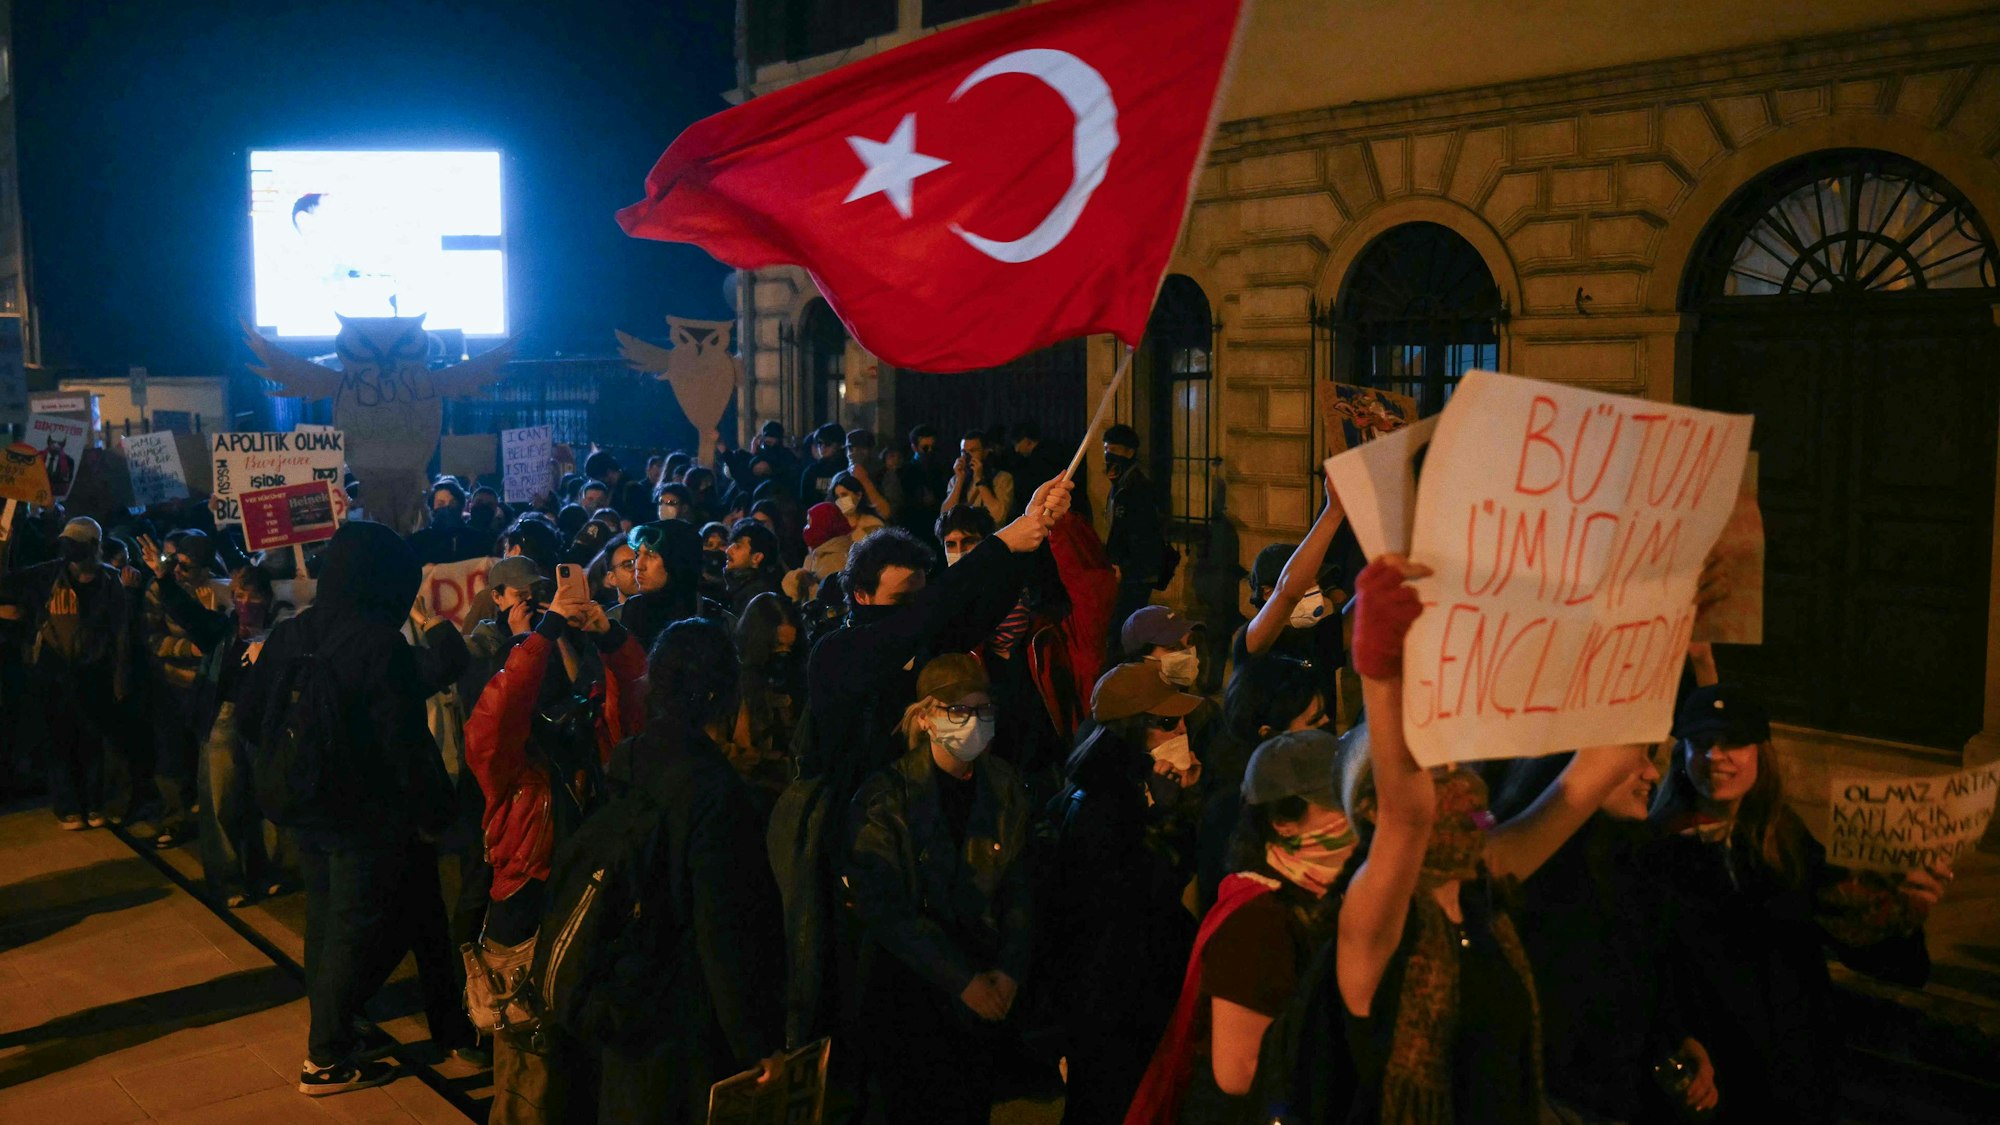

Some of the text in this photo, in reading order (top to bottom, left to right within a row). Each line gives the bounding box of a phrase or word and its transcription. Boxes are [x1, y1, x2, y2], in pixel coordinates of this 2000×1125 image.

[295, 433, 342, 451] OLMAK
[1514, 395, 1733, 510] BÜTÜN
[1844, 781, 1931, 803] OLMAZ
